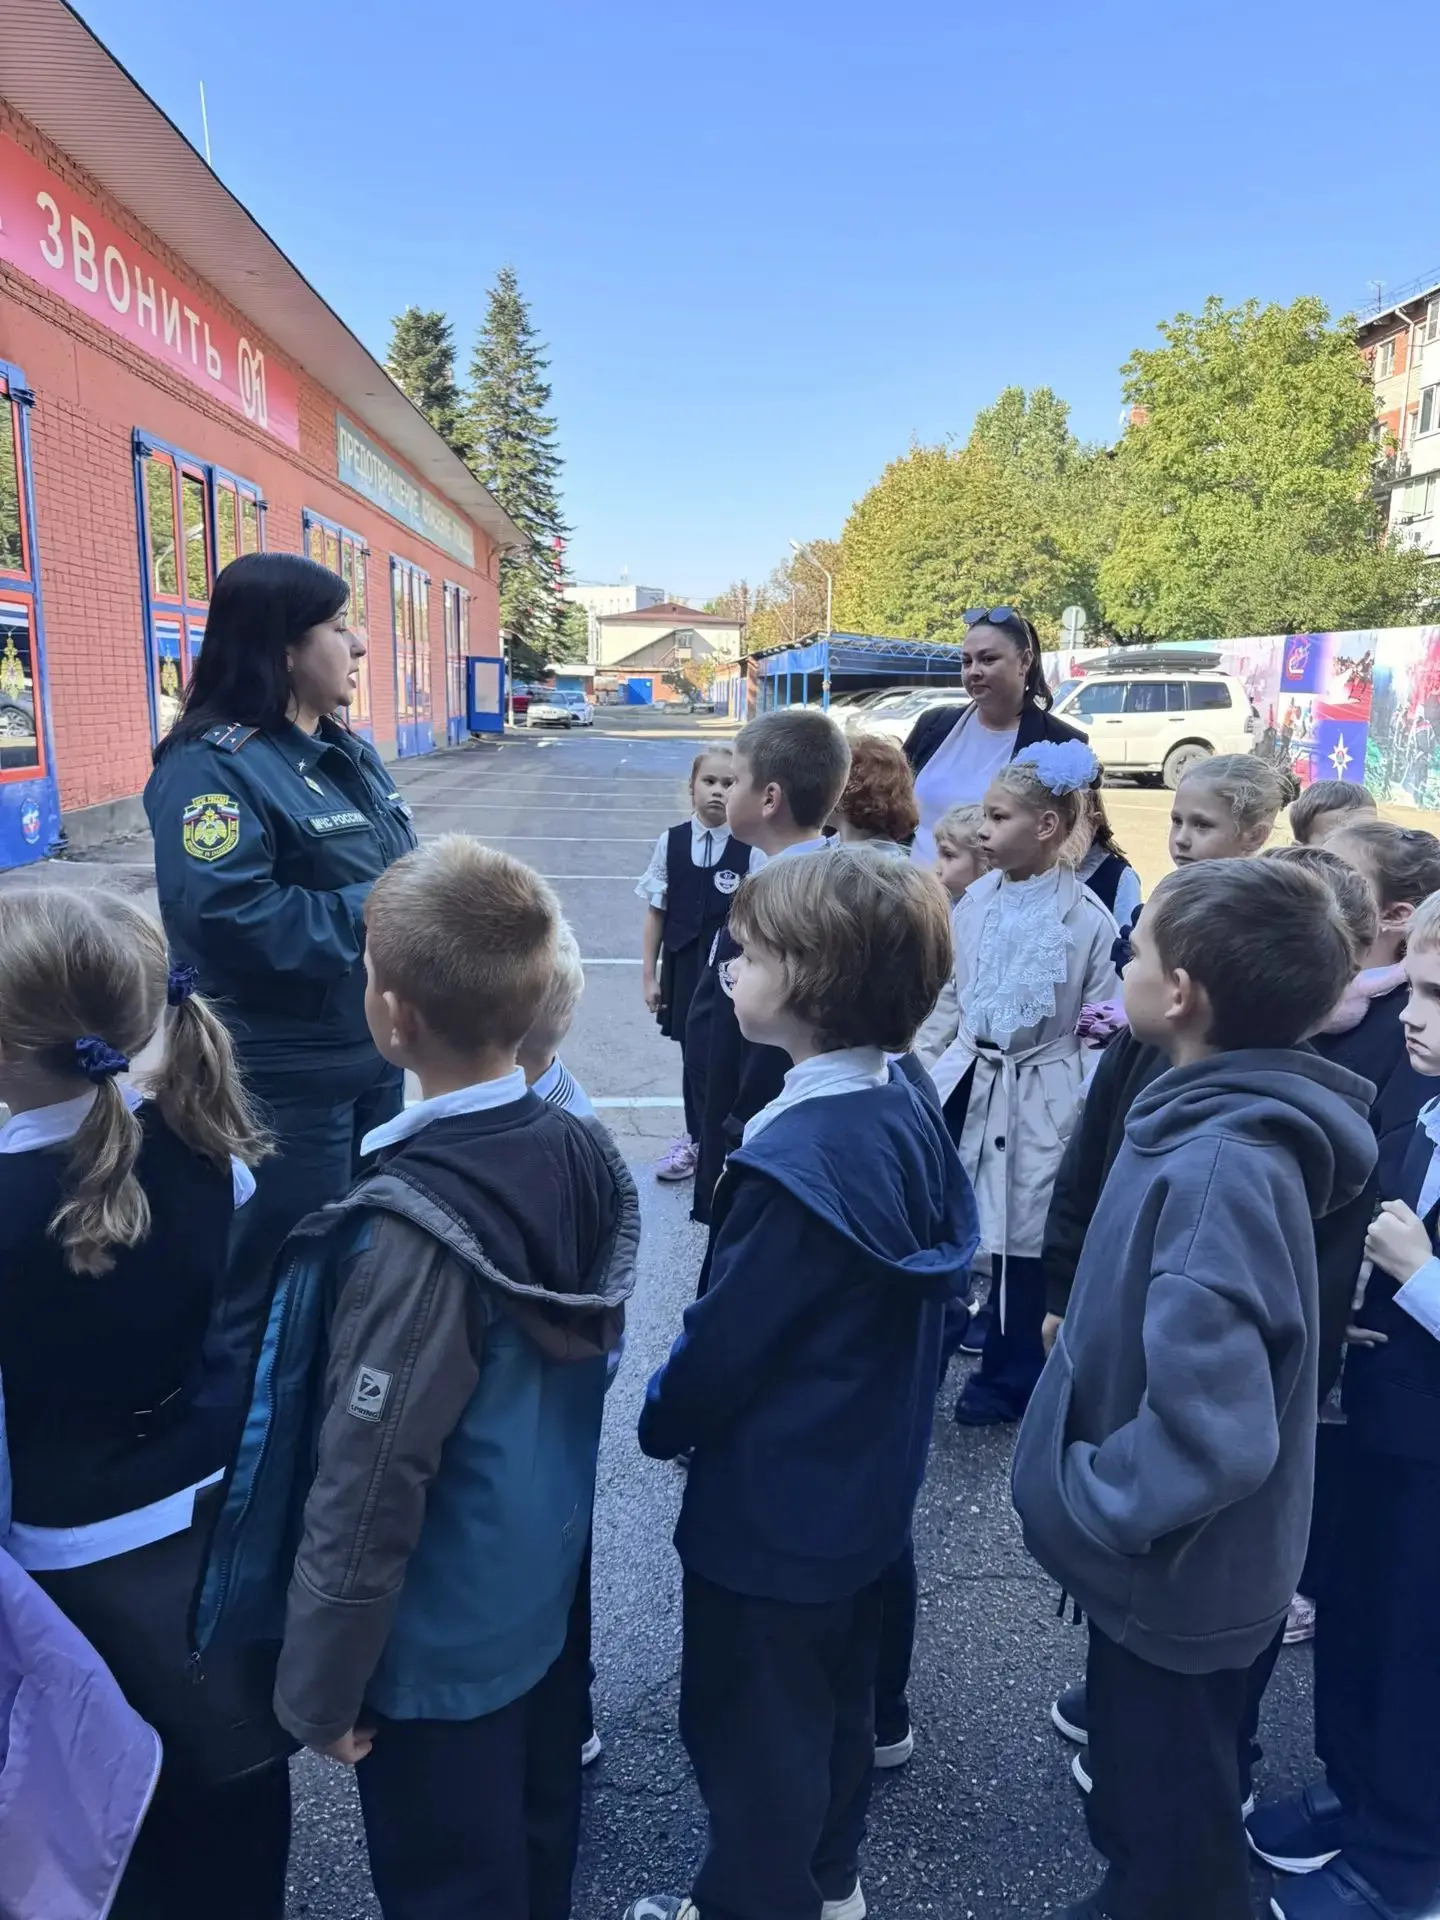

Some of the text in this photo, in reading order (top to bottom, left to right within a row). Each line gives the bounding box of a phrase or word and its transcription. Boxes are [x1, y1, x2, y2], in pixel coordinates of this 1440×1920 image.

[36, 191, 268, 429] ЗВОНИТЬ 01
[309, 817, 333, 830] МЧС
